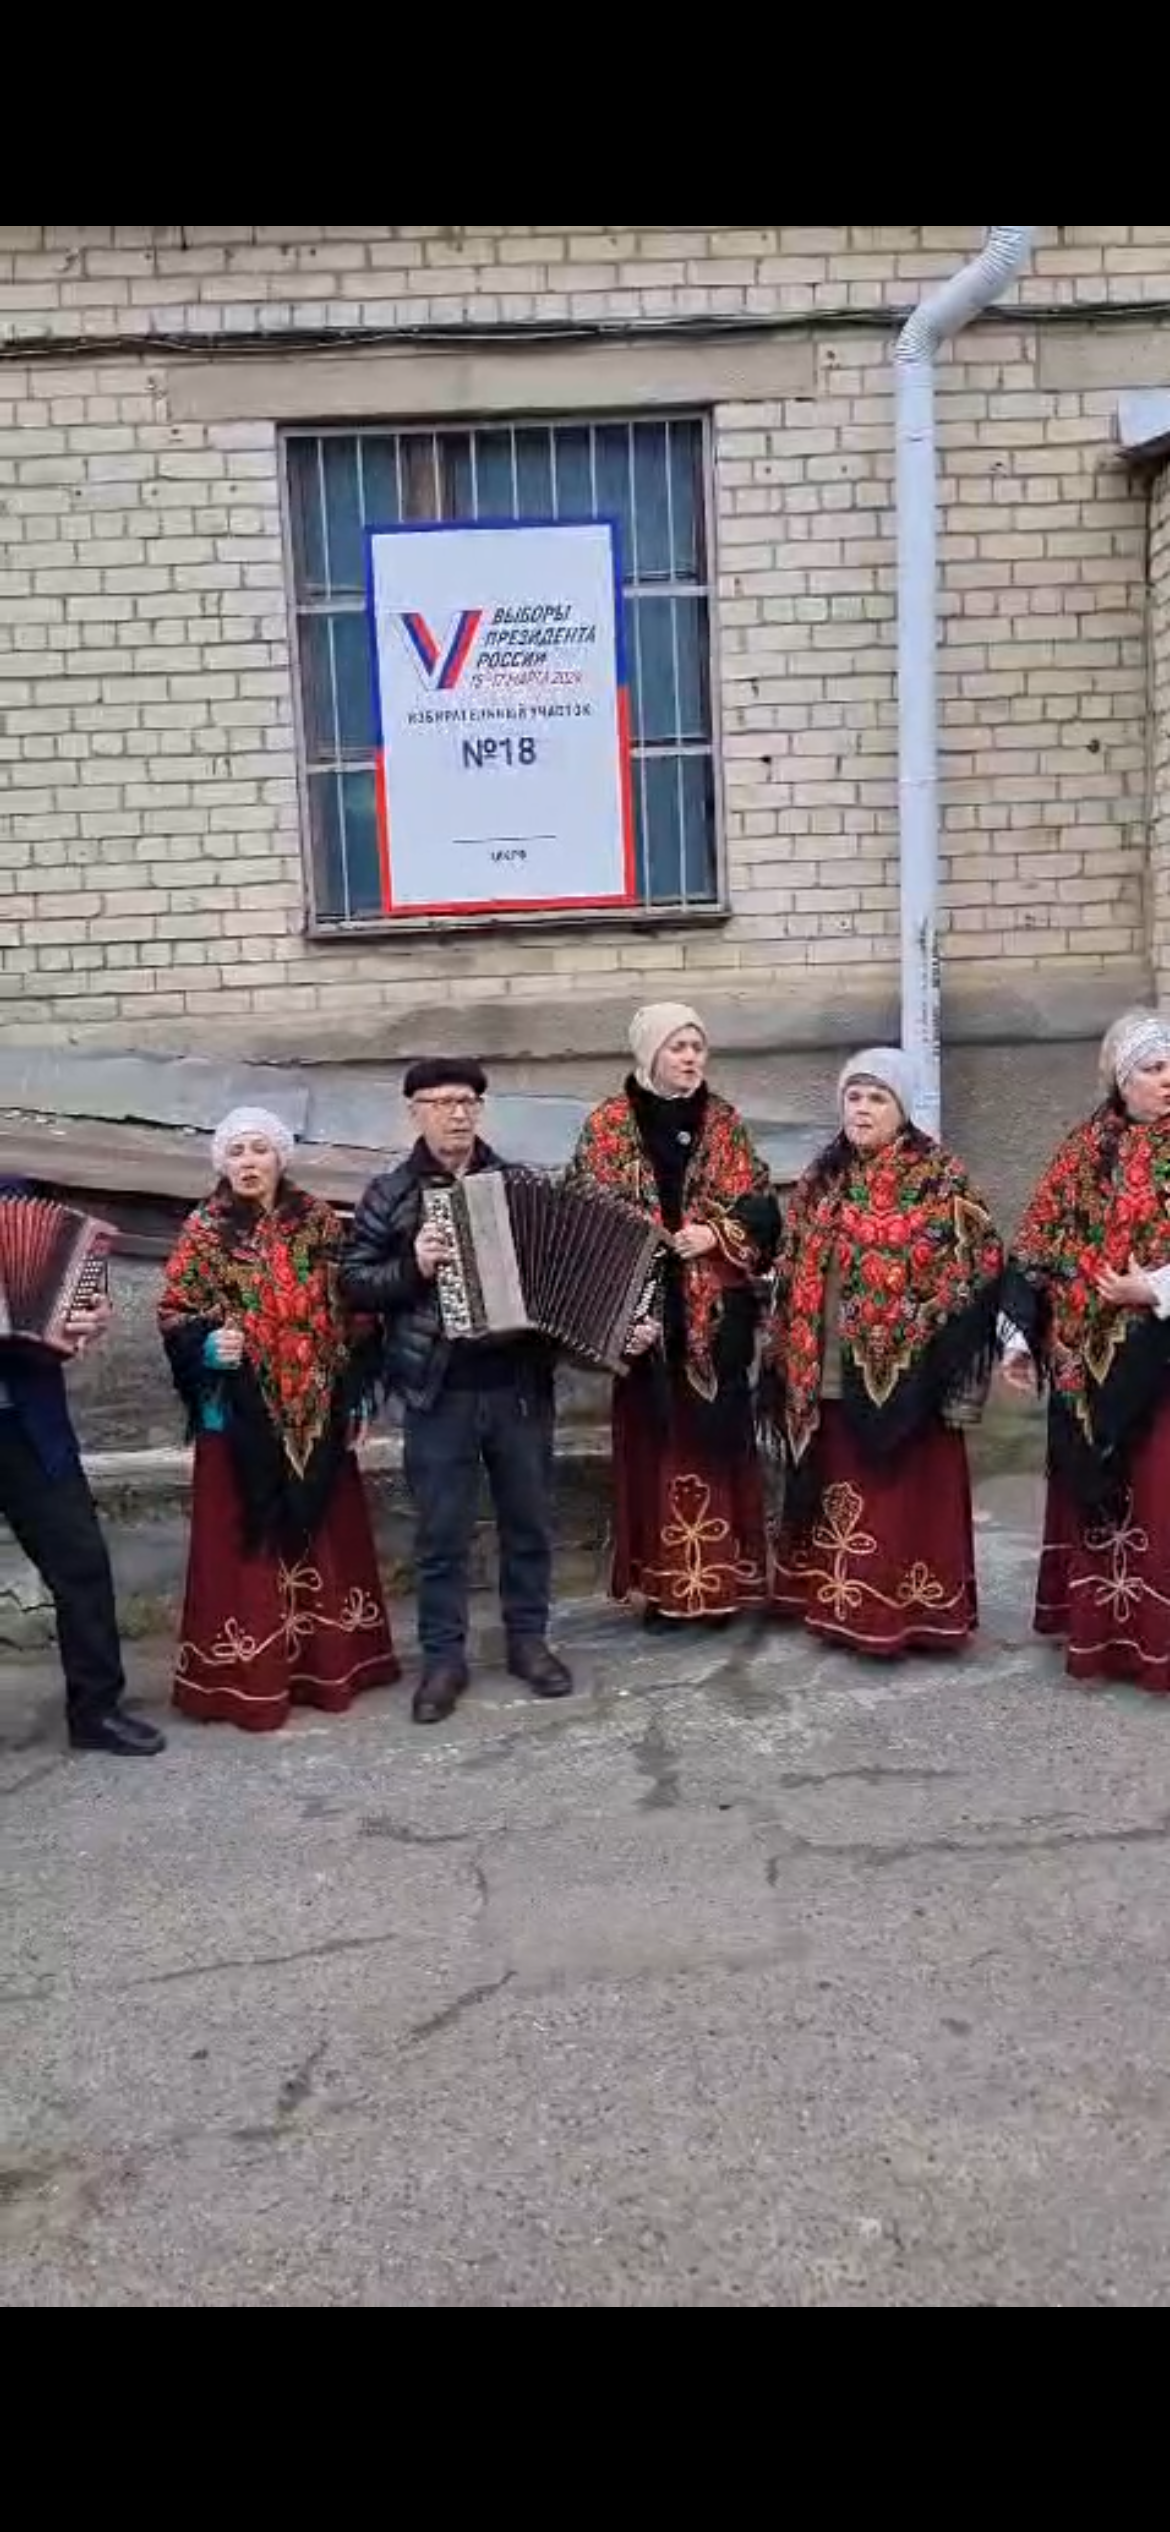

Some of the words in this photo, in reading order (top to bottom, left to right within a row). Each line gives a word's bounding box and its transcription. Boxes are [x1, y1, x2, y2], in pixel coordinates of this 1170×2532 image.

[493, 604, 572, 624] ВЫБОРЫ
[484, 625, 597, 647] ПРЕЗИДЕНТА
[476, 651, 548, 669] РОССИИ
[407, 703, 528, 725] ИЗБИРАТЕЛЬНЫЙ
[530, 702, 592, 719] УЧАСТОК
[461, 736, 537, 769] №18
